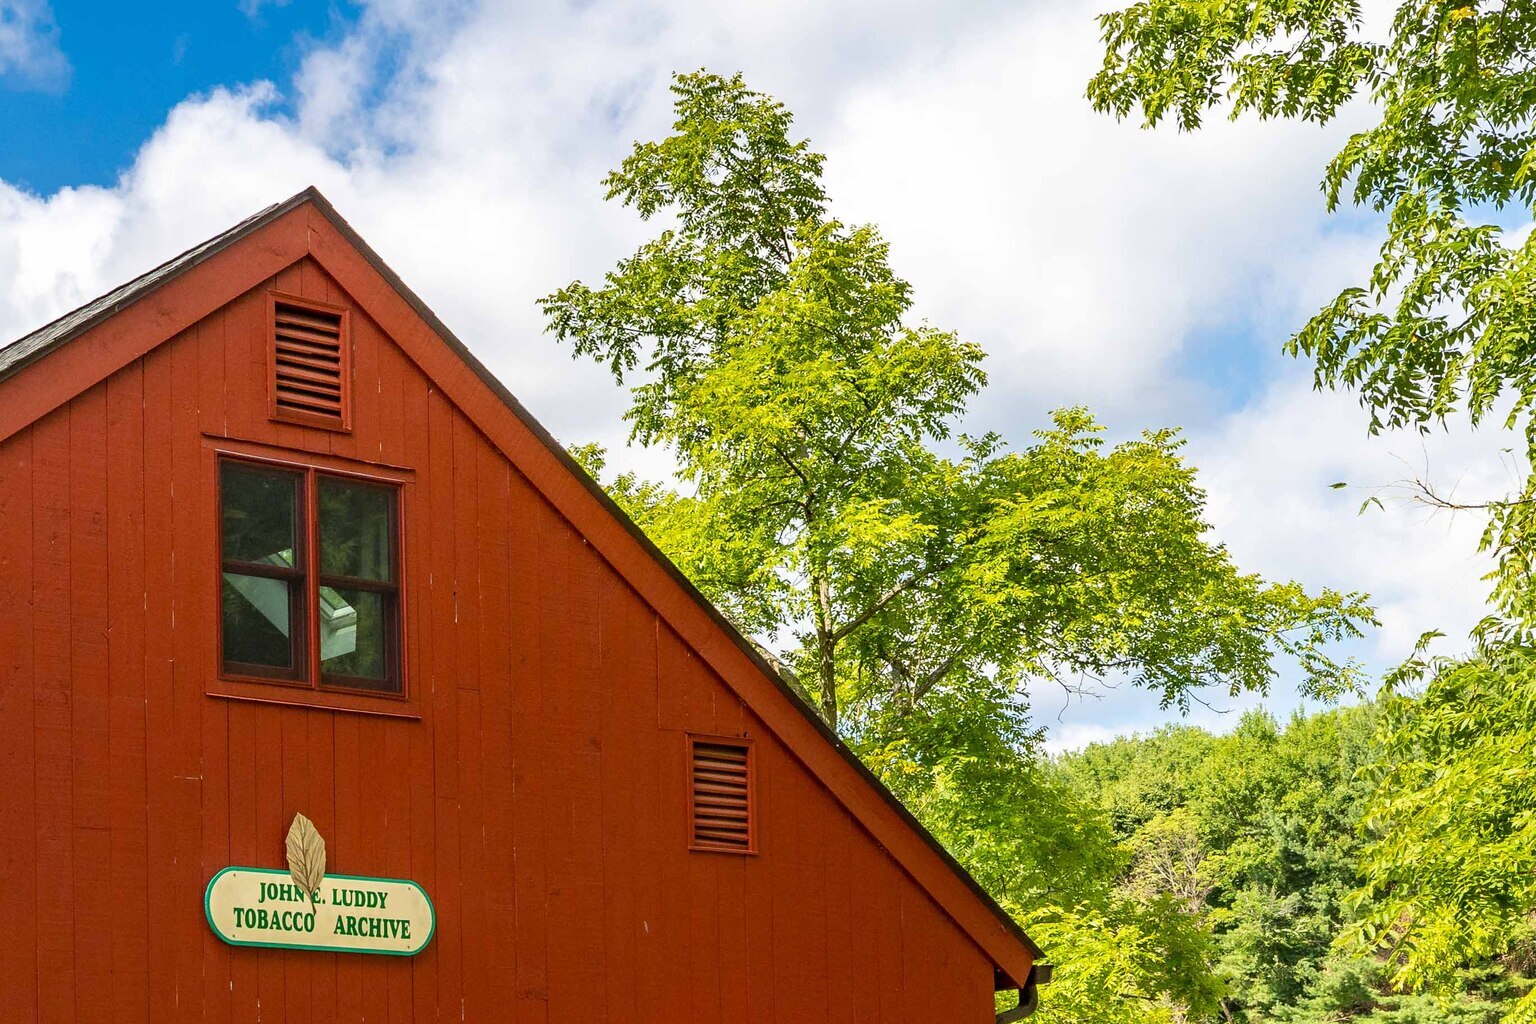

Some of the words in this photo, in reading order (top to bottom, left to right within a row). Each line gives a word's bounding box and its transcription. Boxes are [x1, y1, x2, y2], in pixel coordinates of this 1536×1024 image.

[312, 887, 326, 904] E.
[332, 888, 388, 909] LUDDY
[233, 907, 314, 932] TOBACCO
[334, 915, 411, 939] ARCHIVE
